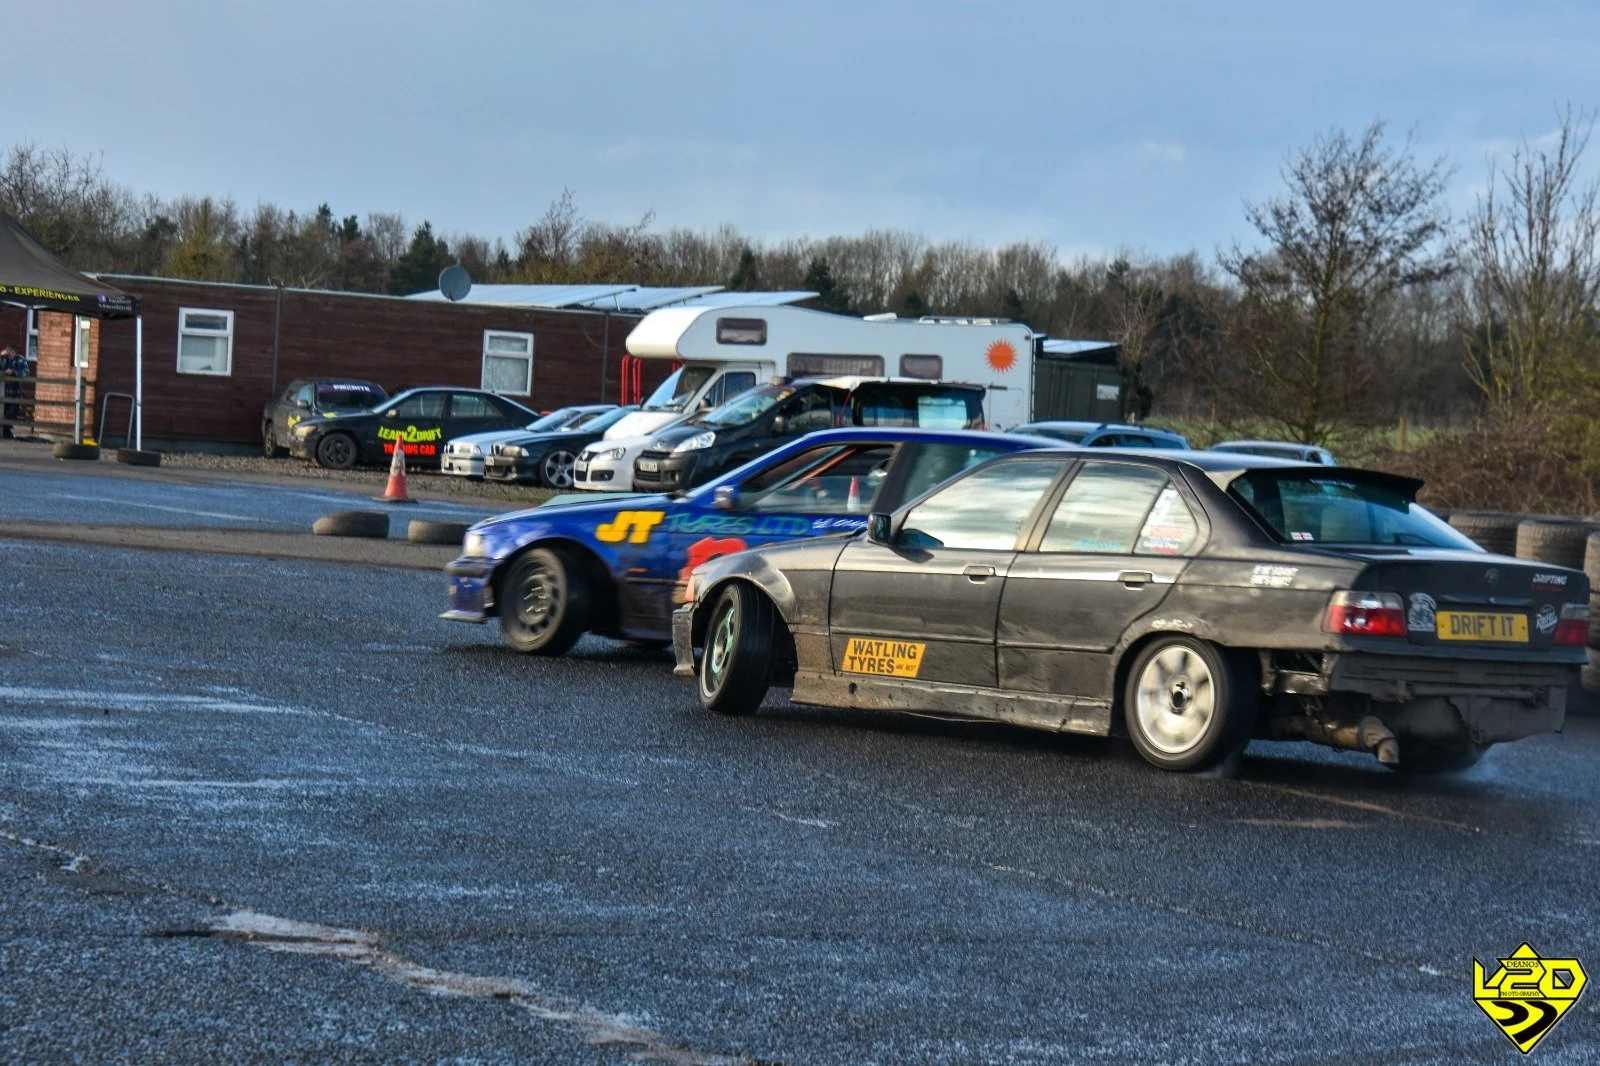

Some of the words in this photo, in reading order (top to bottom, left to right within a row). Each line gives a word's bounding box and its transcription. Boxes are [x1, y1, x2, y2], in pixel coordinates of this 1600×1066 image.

[14, 286, 80, 301] EXPERIENCES
[383, 443, 418, 454] TRING
[420, 444, 436, 455] CAR
[595, 510, 665, 543] JT
[1532, 573, 1568, 586] DRIFTING
[1450, 614, 1497, 636] DRIFT
[1501, 616, 1514, 637] IT
[853, 640, 917, 659] WATLING
[848, 656, 895, 674] TYRES
